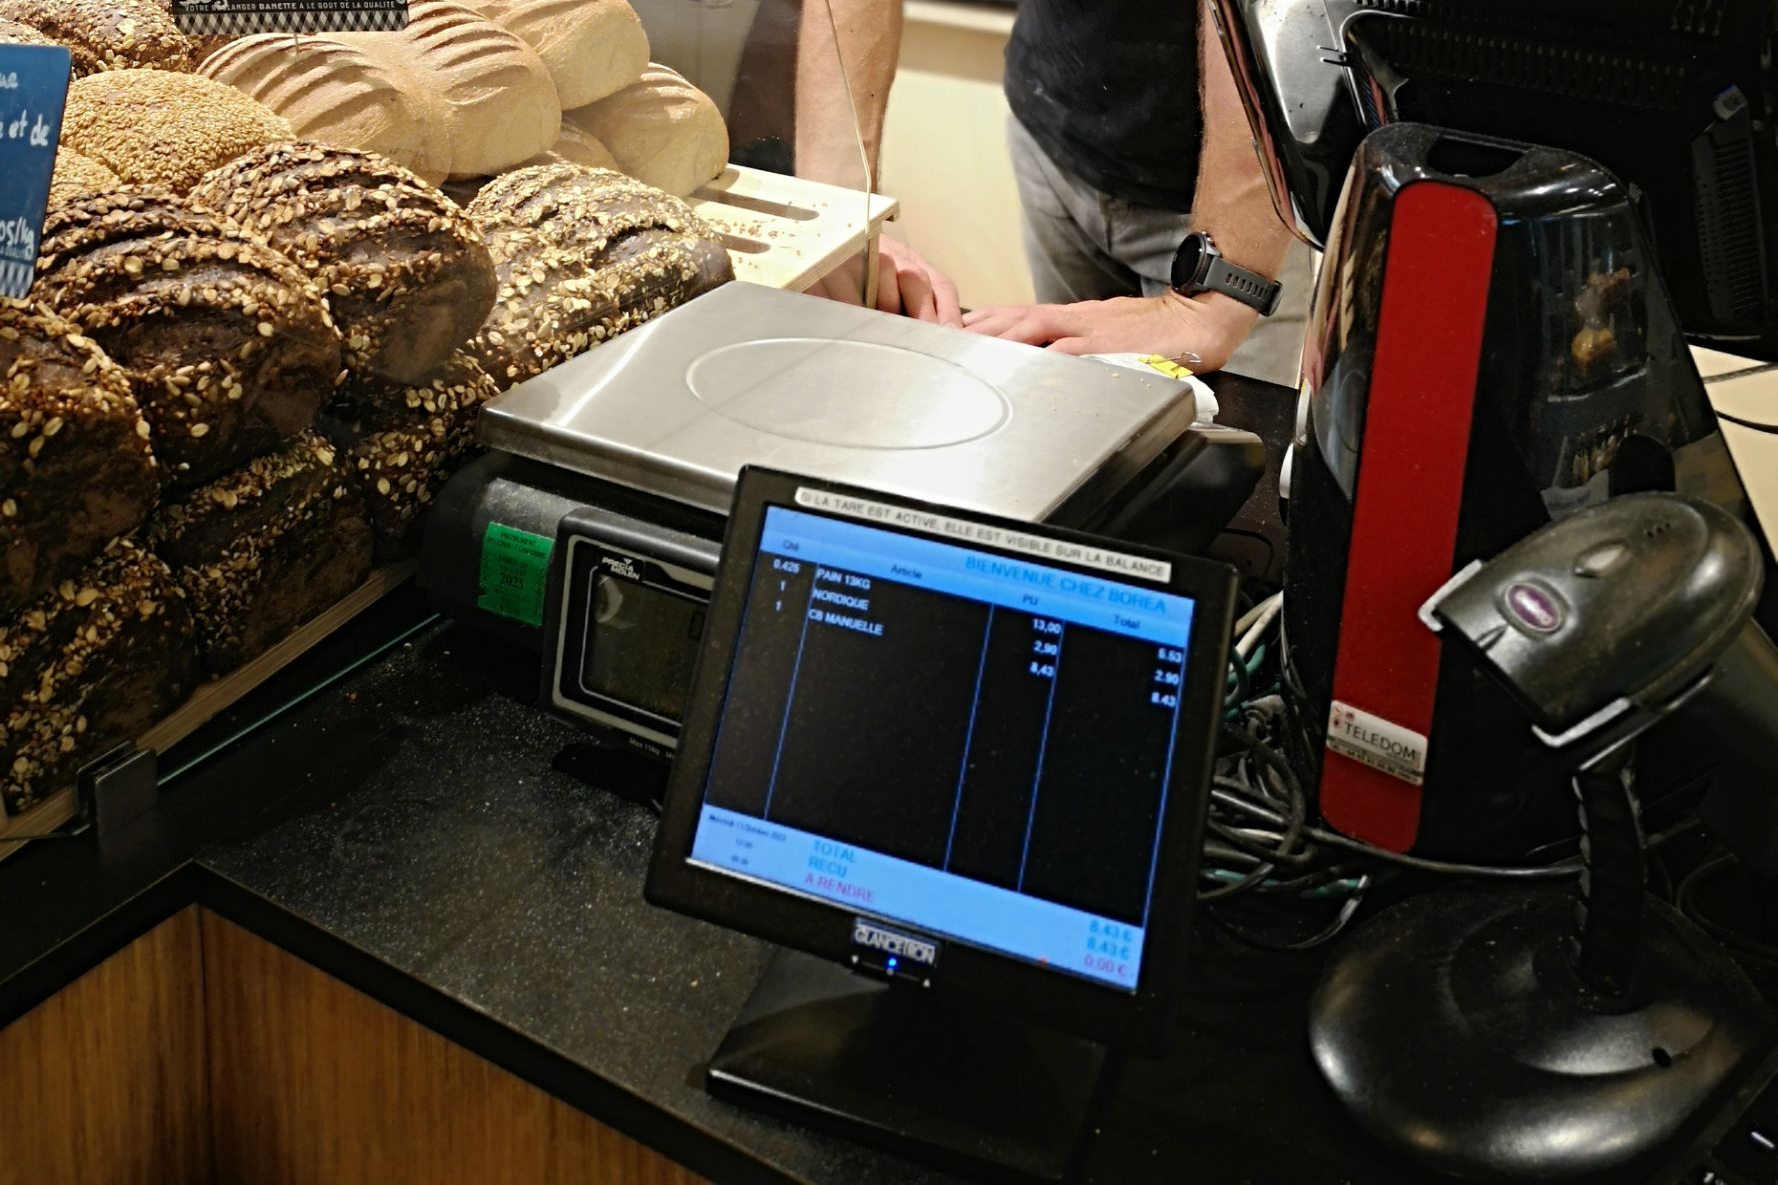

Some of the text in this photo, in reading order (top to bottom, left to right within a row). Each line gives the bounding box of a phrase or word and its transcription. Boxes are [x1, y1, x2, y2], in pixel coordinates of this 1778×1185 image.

[306, 2, 316, 10] LE
[340, 1, 350, 9] DE
[352, 1, 362, 9] LA
[801, 491, 1166, 578] SI LA TARE EST ACTIVE, ELLE EST VISIBLE SUR LA BALANCE
[816, 567, 871, 591] PAIN 13KG
[890, 562, 923, 580] Article
[780, 579, 787, 592] 1
[965, 555, 1167, 613] BIENVENUE CHEZ BOREA
[812, 587, 870, 612] NORDIQUE
[1022, 593, 1039, 607] PU
[807, 607, 884, 636] CB MANUELLE
[1113, 614, 1141, 631] Total
[1345, 721, 1417, 760] TELEDOM
[813, 839, 857, 863] TOTAL
[804, 872, 877, 904] A RENDRE
